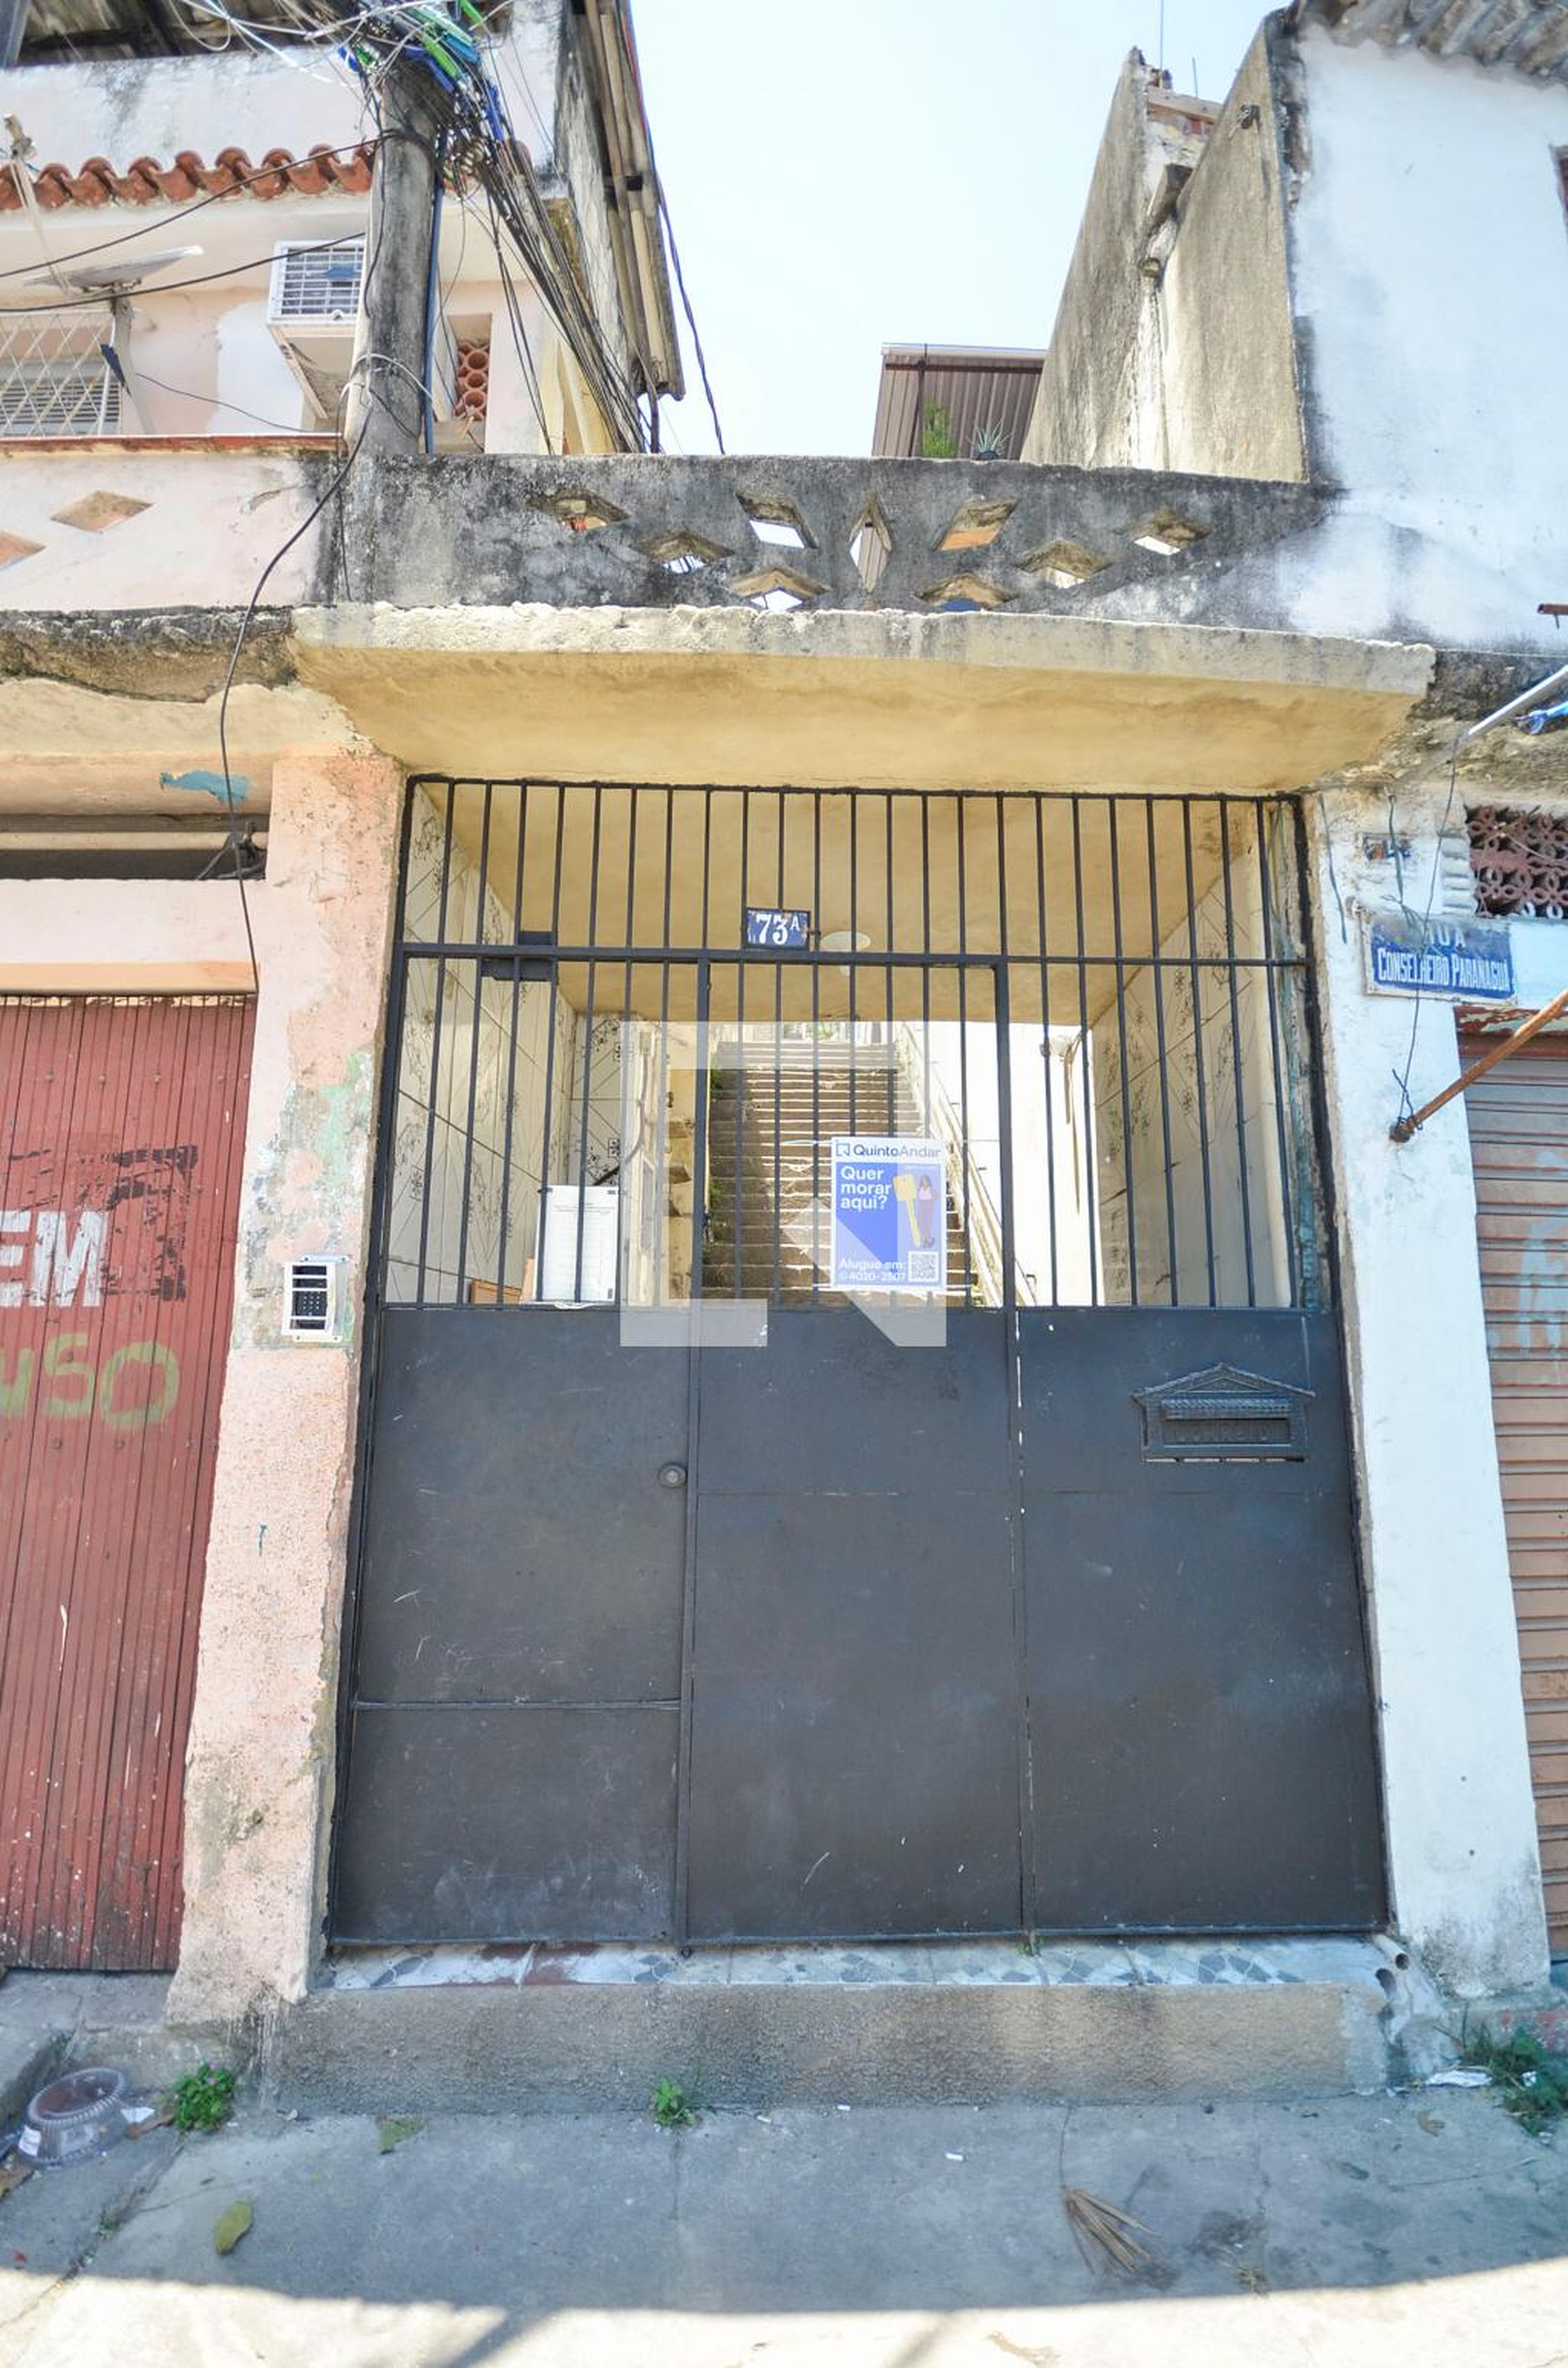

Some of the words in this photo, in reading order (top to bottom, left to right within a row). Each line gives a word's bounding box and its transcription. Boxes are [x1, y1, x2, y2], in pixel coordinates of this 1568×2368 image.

[853, 1144, 940, 1158] QuintoAndar
[840, 1166, 884, 1180] Quer
[840, 1183, 892, 1195] morar
[840, 1195, 887, 1212] aqui?
[838, 1259, 882, 1272] Alugue
